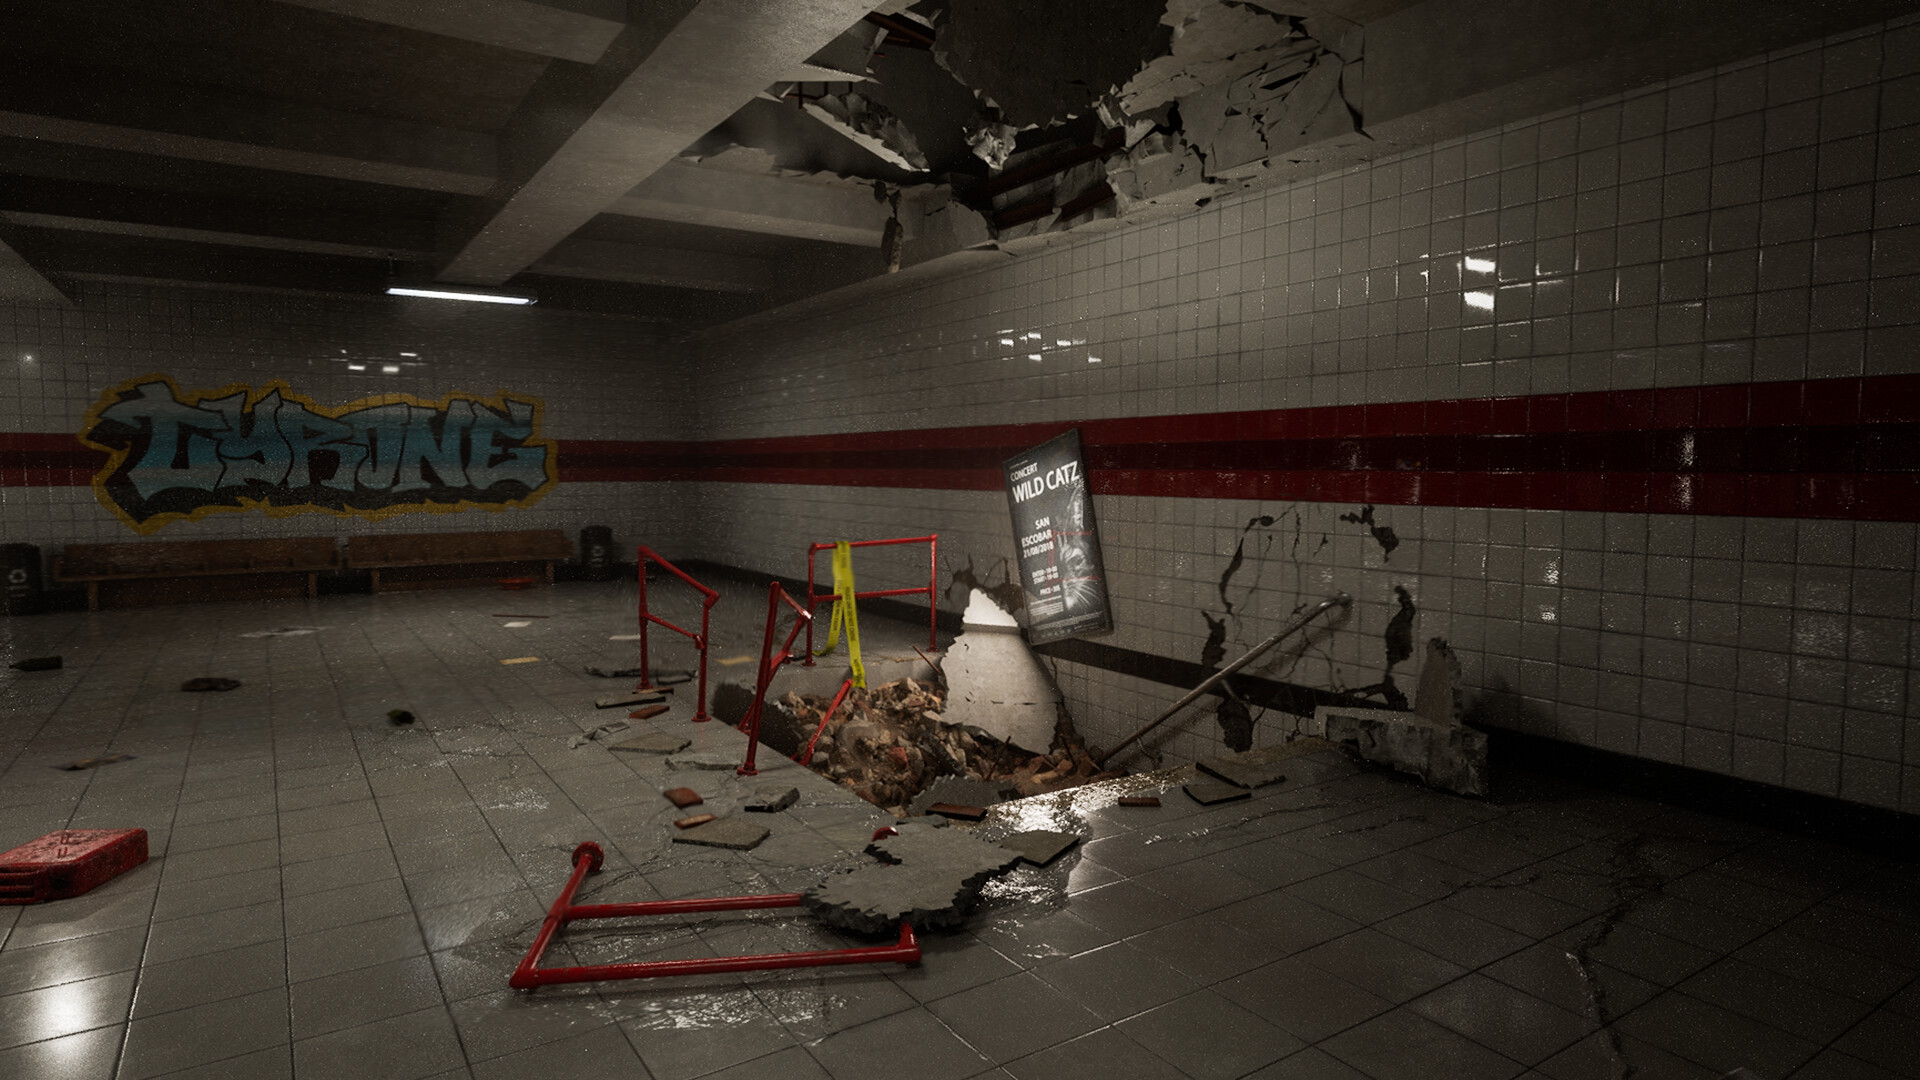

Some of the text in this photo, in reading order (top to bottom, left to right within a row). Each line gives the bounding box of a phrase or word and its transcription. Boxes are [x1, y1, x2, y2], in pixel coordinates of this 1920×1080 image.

[87, 378, 552, 511] TYRONE
[1010, 462, 1038, 482] CONCERT
[1012, 461, 1080, 503] WILD CATZ
[1035, 516, 1050, 530] SAN
[1021, 529, 1053, 548] ESCOBAR
